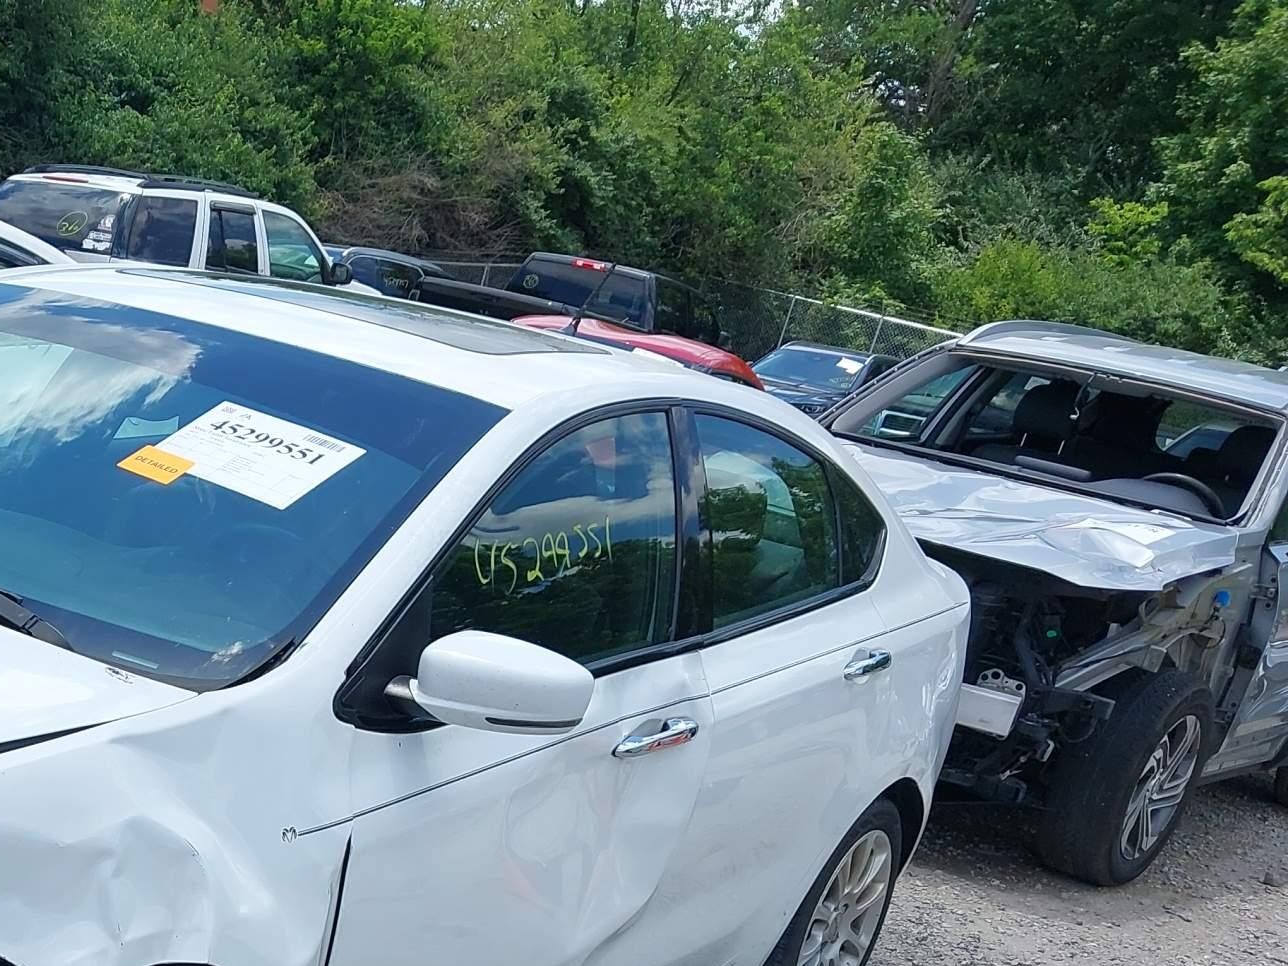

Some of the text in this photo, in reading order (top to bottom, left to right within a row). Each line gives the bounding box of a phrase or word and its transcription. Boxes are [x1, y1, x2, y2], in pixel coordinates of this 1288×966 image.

[135, 455, 179, 474] DETAILED
[209, 419, 326, 465] 45299551
[474, 515, 613, 596] 45299551
